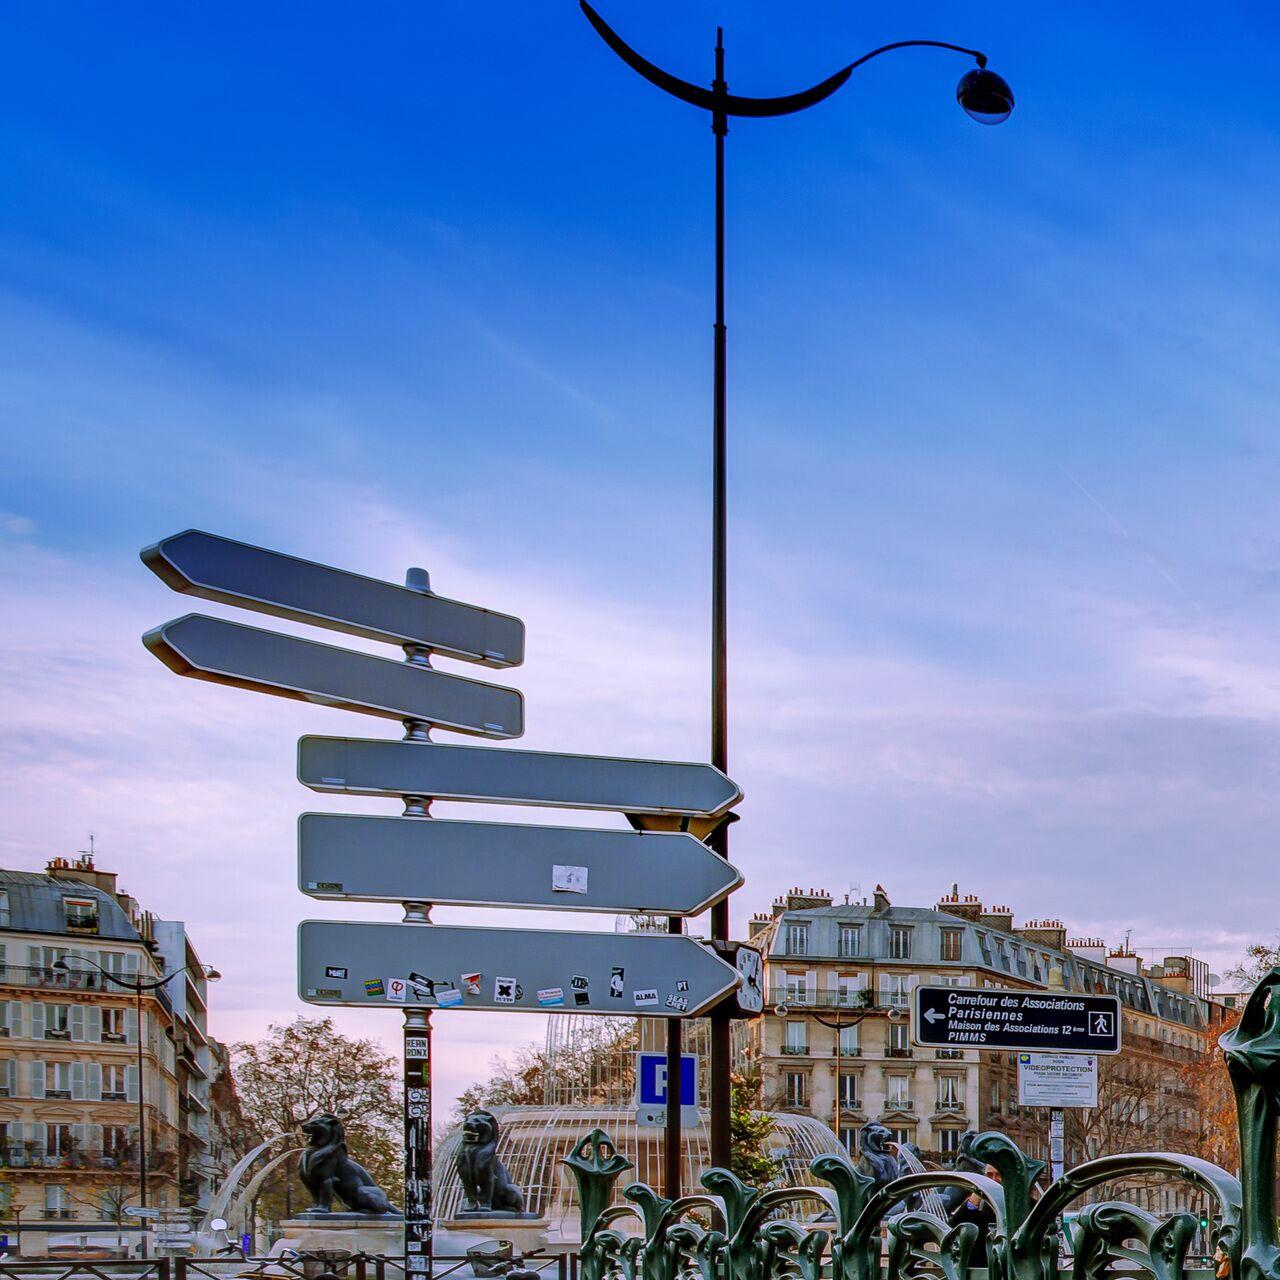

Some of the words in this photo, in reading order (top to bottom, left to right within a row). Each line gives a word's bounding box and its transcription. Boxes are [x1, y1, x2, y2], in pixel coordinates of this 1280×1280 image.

[635, 992, 657, 1001] ALMA
[947, 992, 998, 1006] Carrefour
[1000, 995, 1019, 1008] des
[1021, 996, 1085, 1011] Associations
[948, 1006, 1024, 1021] Parisiennes
[947, 1019, 982, 1030] Maison
[984, 1021, 1000, 1032] des
[1002, 1022, 1060, 1035] Associations
[1061, 1025, 1072, 1035] 12
[947, 1031, 987, 1043] PIMMS
